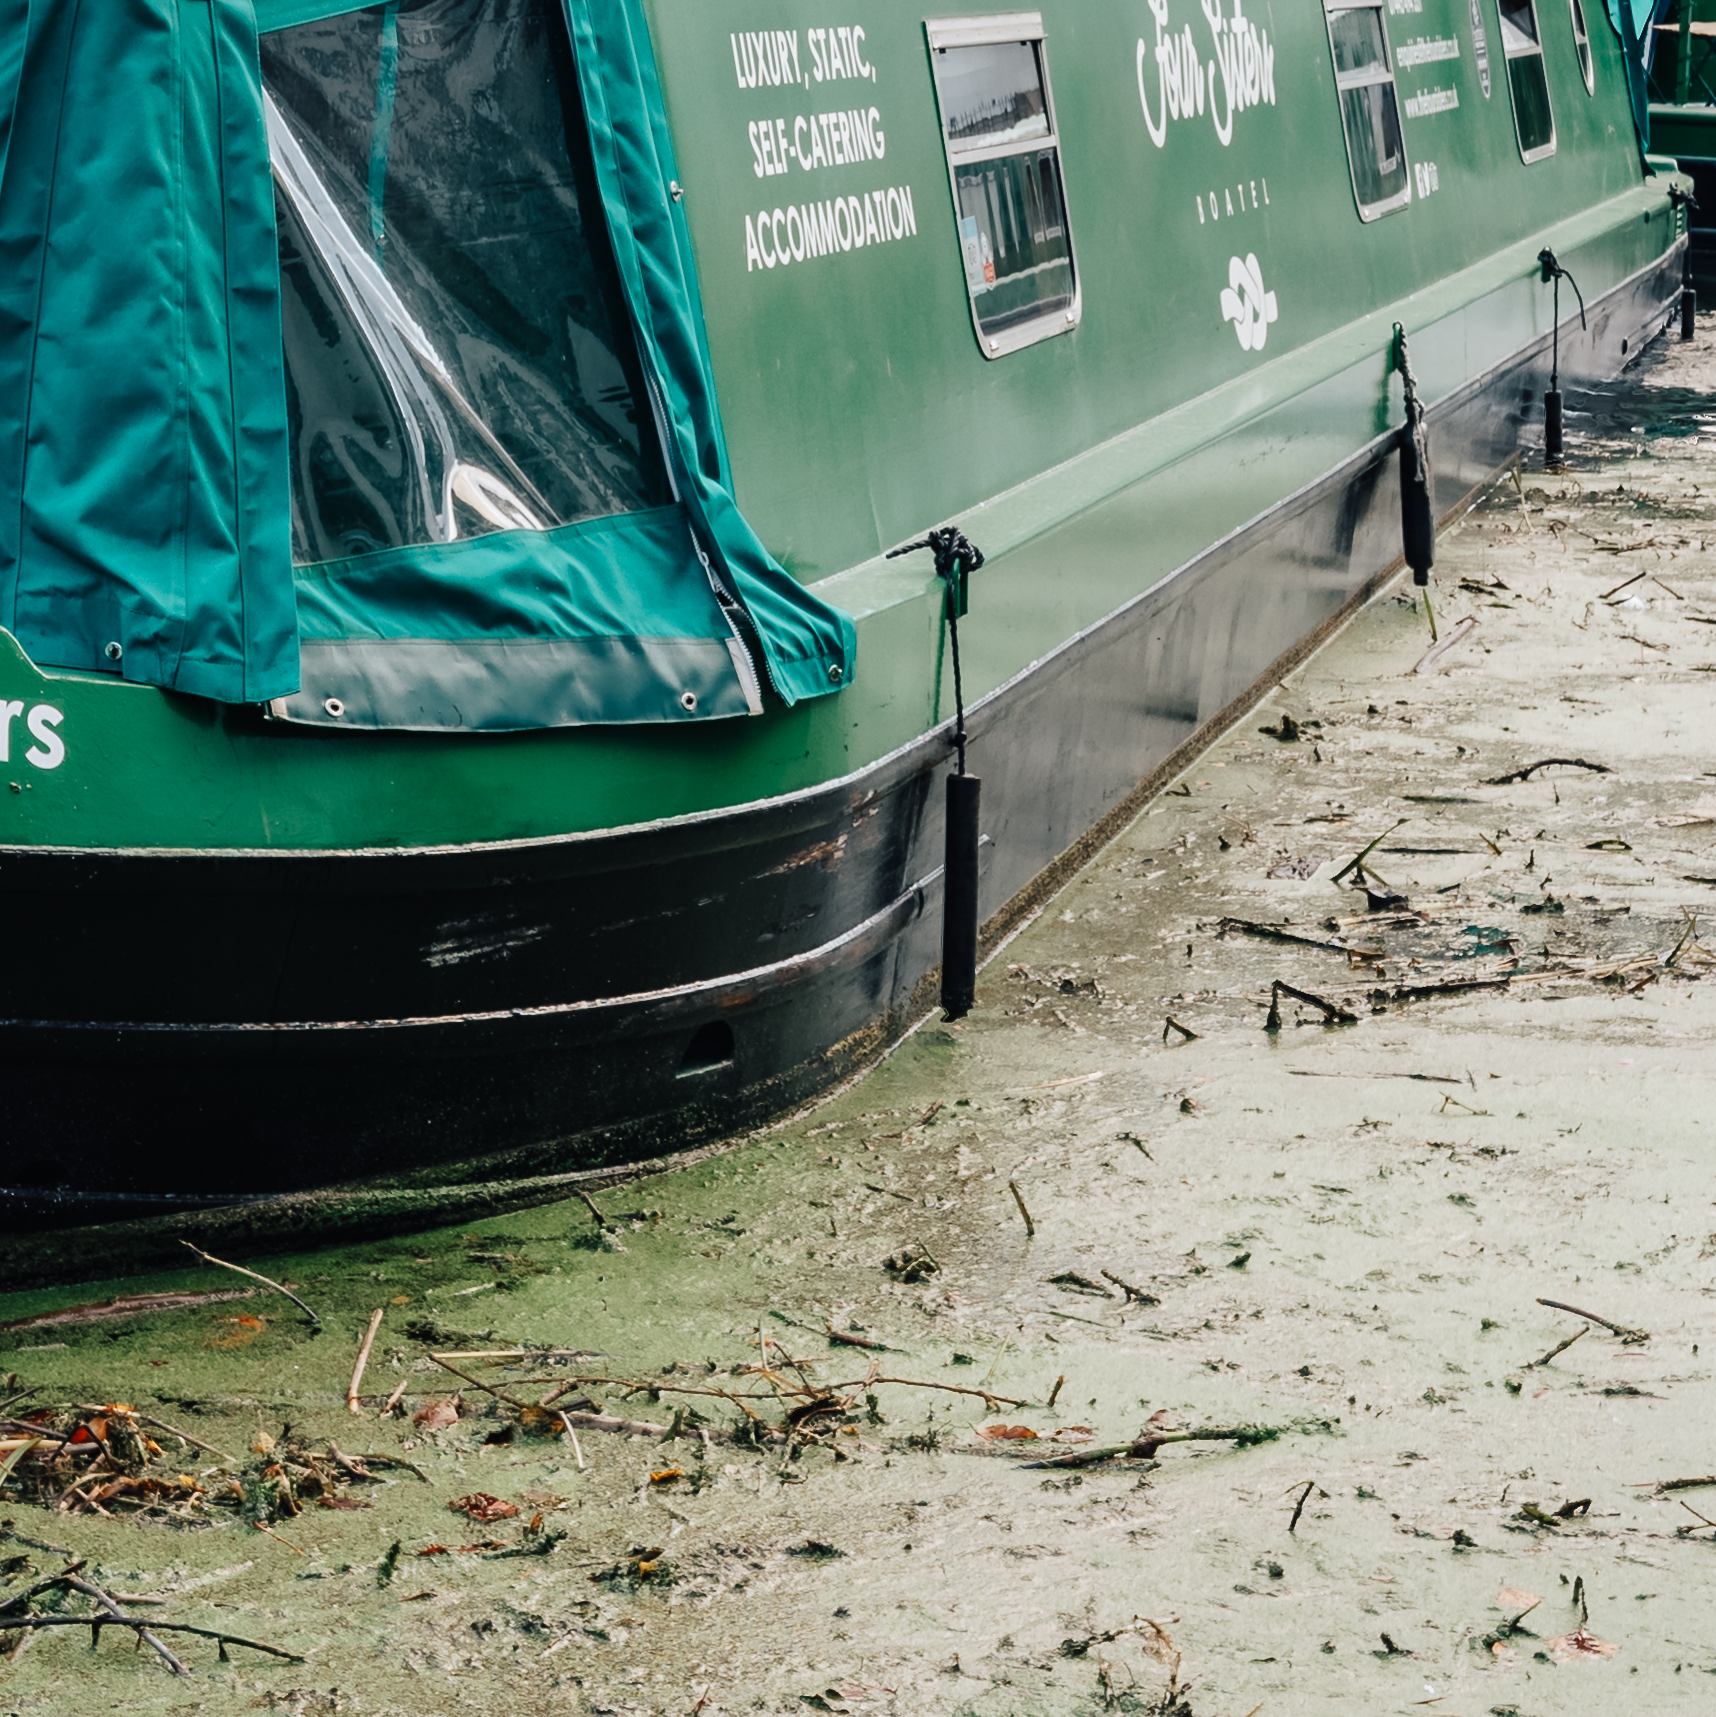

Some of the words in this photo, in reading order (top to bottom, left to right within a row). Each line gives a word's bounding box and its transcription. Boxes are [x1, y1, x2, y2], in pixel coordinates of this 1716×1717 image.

[730, 29, 810, 90] LUXURY,
[807, 25, 877, 84] STATIC,
[747, 106, 885, 178] SELF-CATERING
[744, 185, 917, 273] ACCOMMODATION
[1196, 178, 1270, 225] BOATEL
